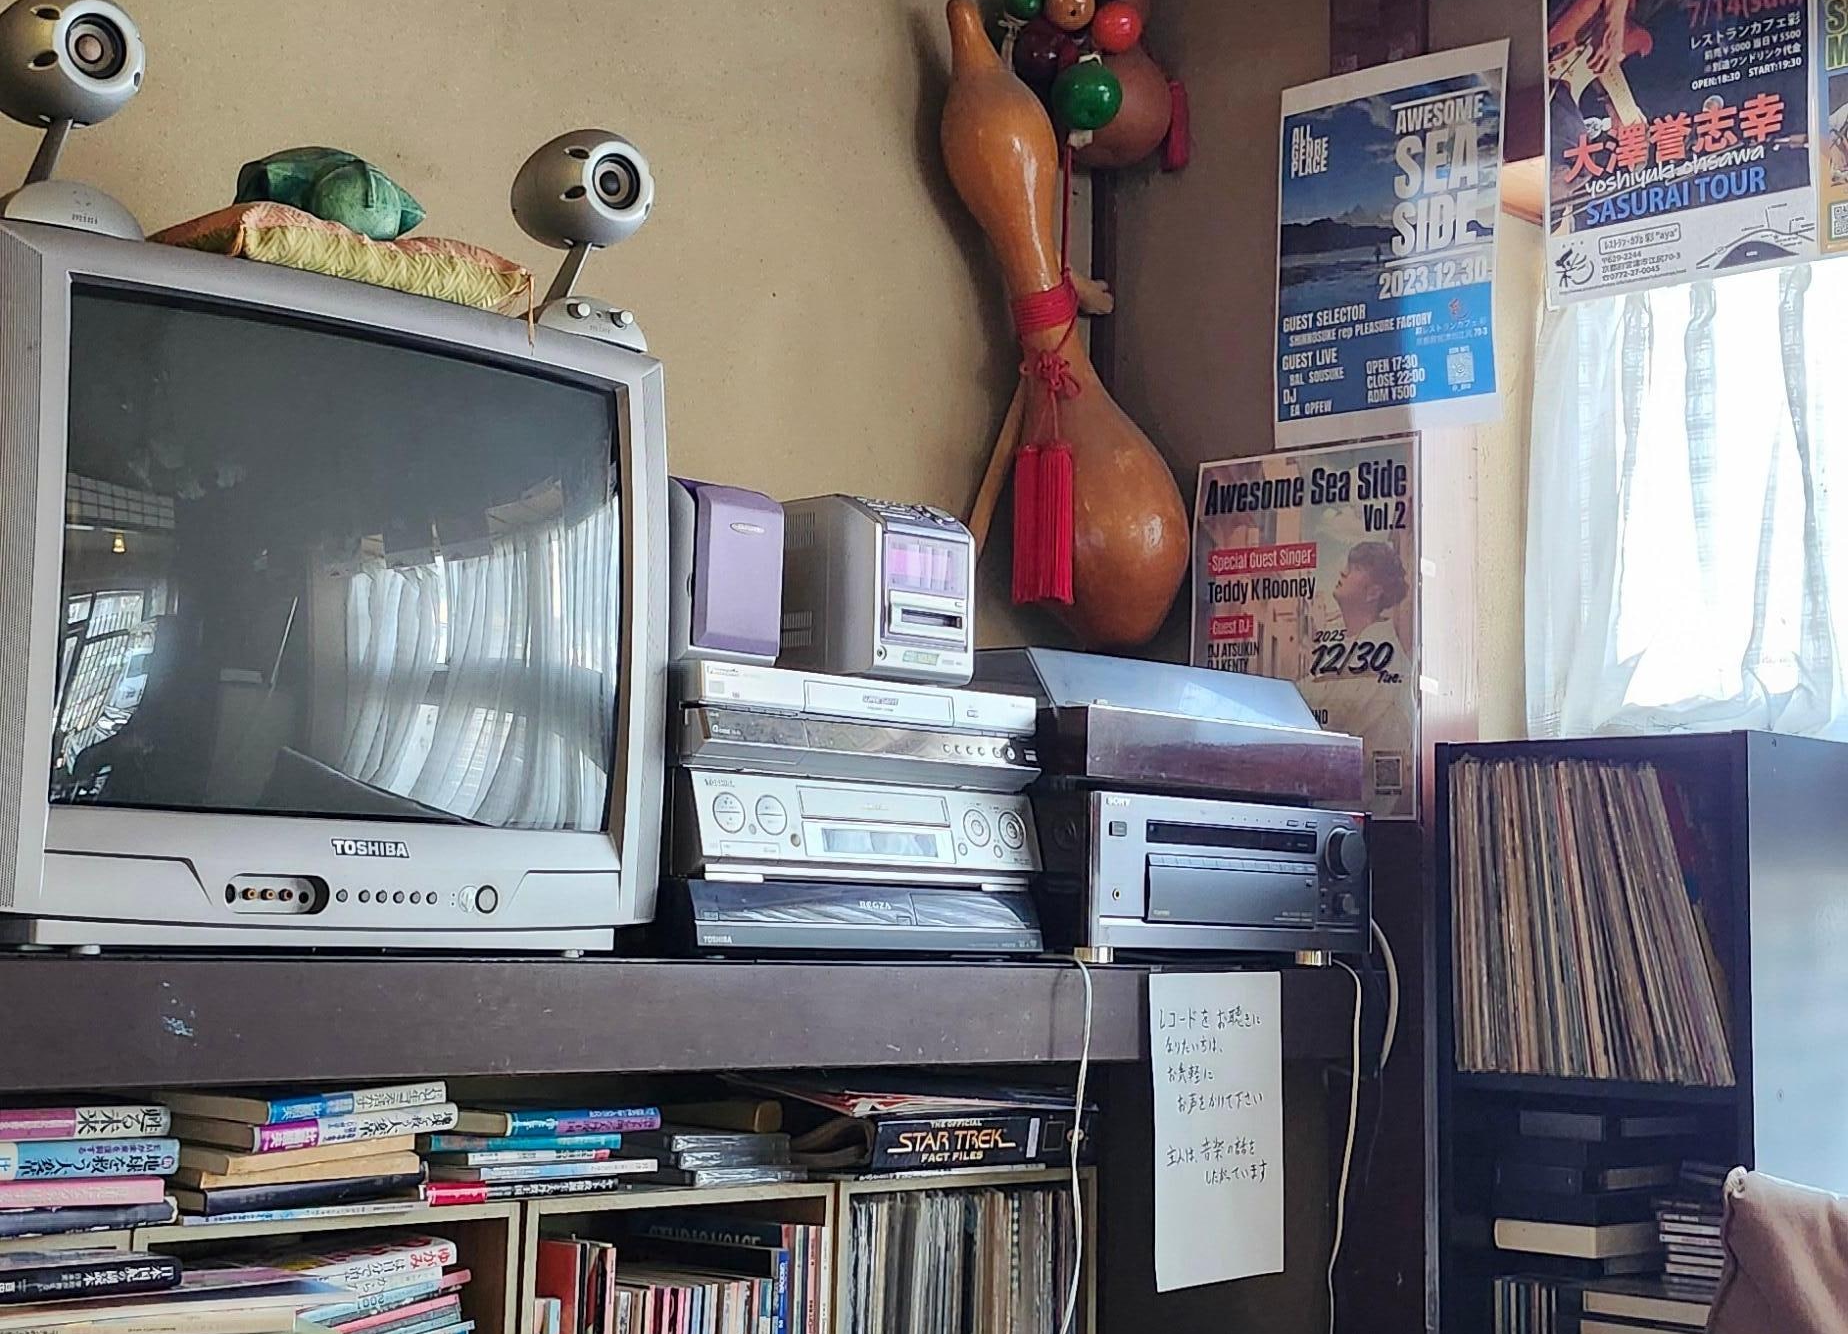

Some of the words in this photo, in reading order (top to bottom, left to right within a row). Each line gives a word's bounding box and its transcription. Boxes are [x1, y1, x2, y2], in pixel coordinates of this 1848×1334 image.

[1395, 93, 1484, 135] AWESOME
[1292, 124, 1312, 144] ALL
[1564, 93, 1785, 183] 大澤誉志幸
[1291, 160, 1328, 179] PLACE
[1394, 122, 1479, 199] SEA
[1586, 181, 1691, 225] SASURAI
[1694, 166, 1767, 204] TOUR
[1392, 189, 1479, 257] SIDE
[1283, 315, 1314, 333] GUEST
[1316, 303, 1366, 328] SELECTOR
[1396, 311, 1433, 331] FACTORY
[1282, 352, 1313, 371] GUEST
[1316, 347, 1338, 367] LIVE
[1366, 359, 1390, 375] OPEN
[1391, 354, 1418, 370] 17:30
[1367, 373, 1395, 389] CLOSE
[1397, 368, 1425, 384] 22:00
[1283, 388, 1296, 405] DJ
[1367, 388, 1389, 403] ADM
[1204, 473, 1305, 516] Awesome
[1311, 466, 1350, 503] Sea
[1357, 458, 1407, 501] Side
[1363, 501, 1406, 532] Vol.2
[1250, 549, 1278, 568] Guest
[1208, 581, 1248, 605] Teddy
[1251, 579, 1260, 600] K
[1262, 576, 1316, 601] Rooney
[1314, 629, 1347, 644] 2025
[1208, 644, 1220, 659] DJ
[1309, 641, 1394, 677] 12/30
[1376, 670, 1403, 684] Tue.
[331, 838, 410, 858] TOSHIBA
[703, 935, 733, 945] TOSHIBA
[887, 1131, 949, 1154] STAR
[954, 1128, 1016, 1150] TREK
[921, 1153, 949, 1164] FACT
[952, 1150, 983, 1162] FILES
